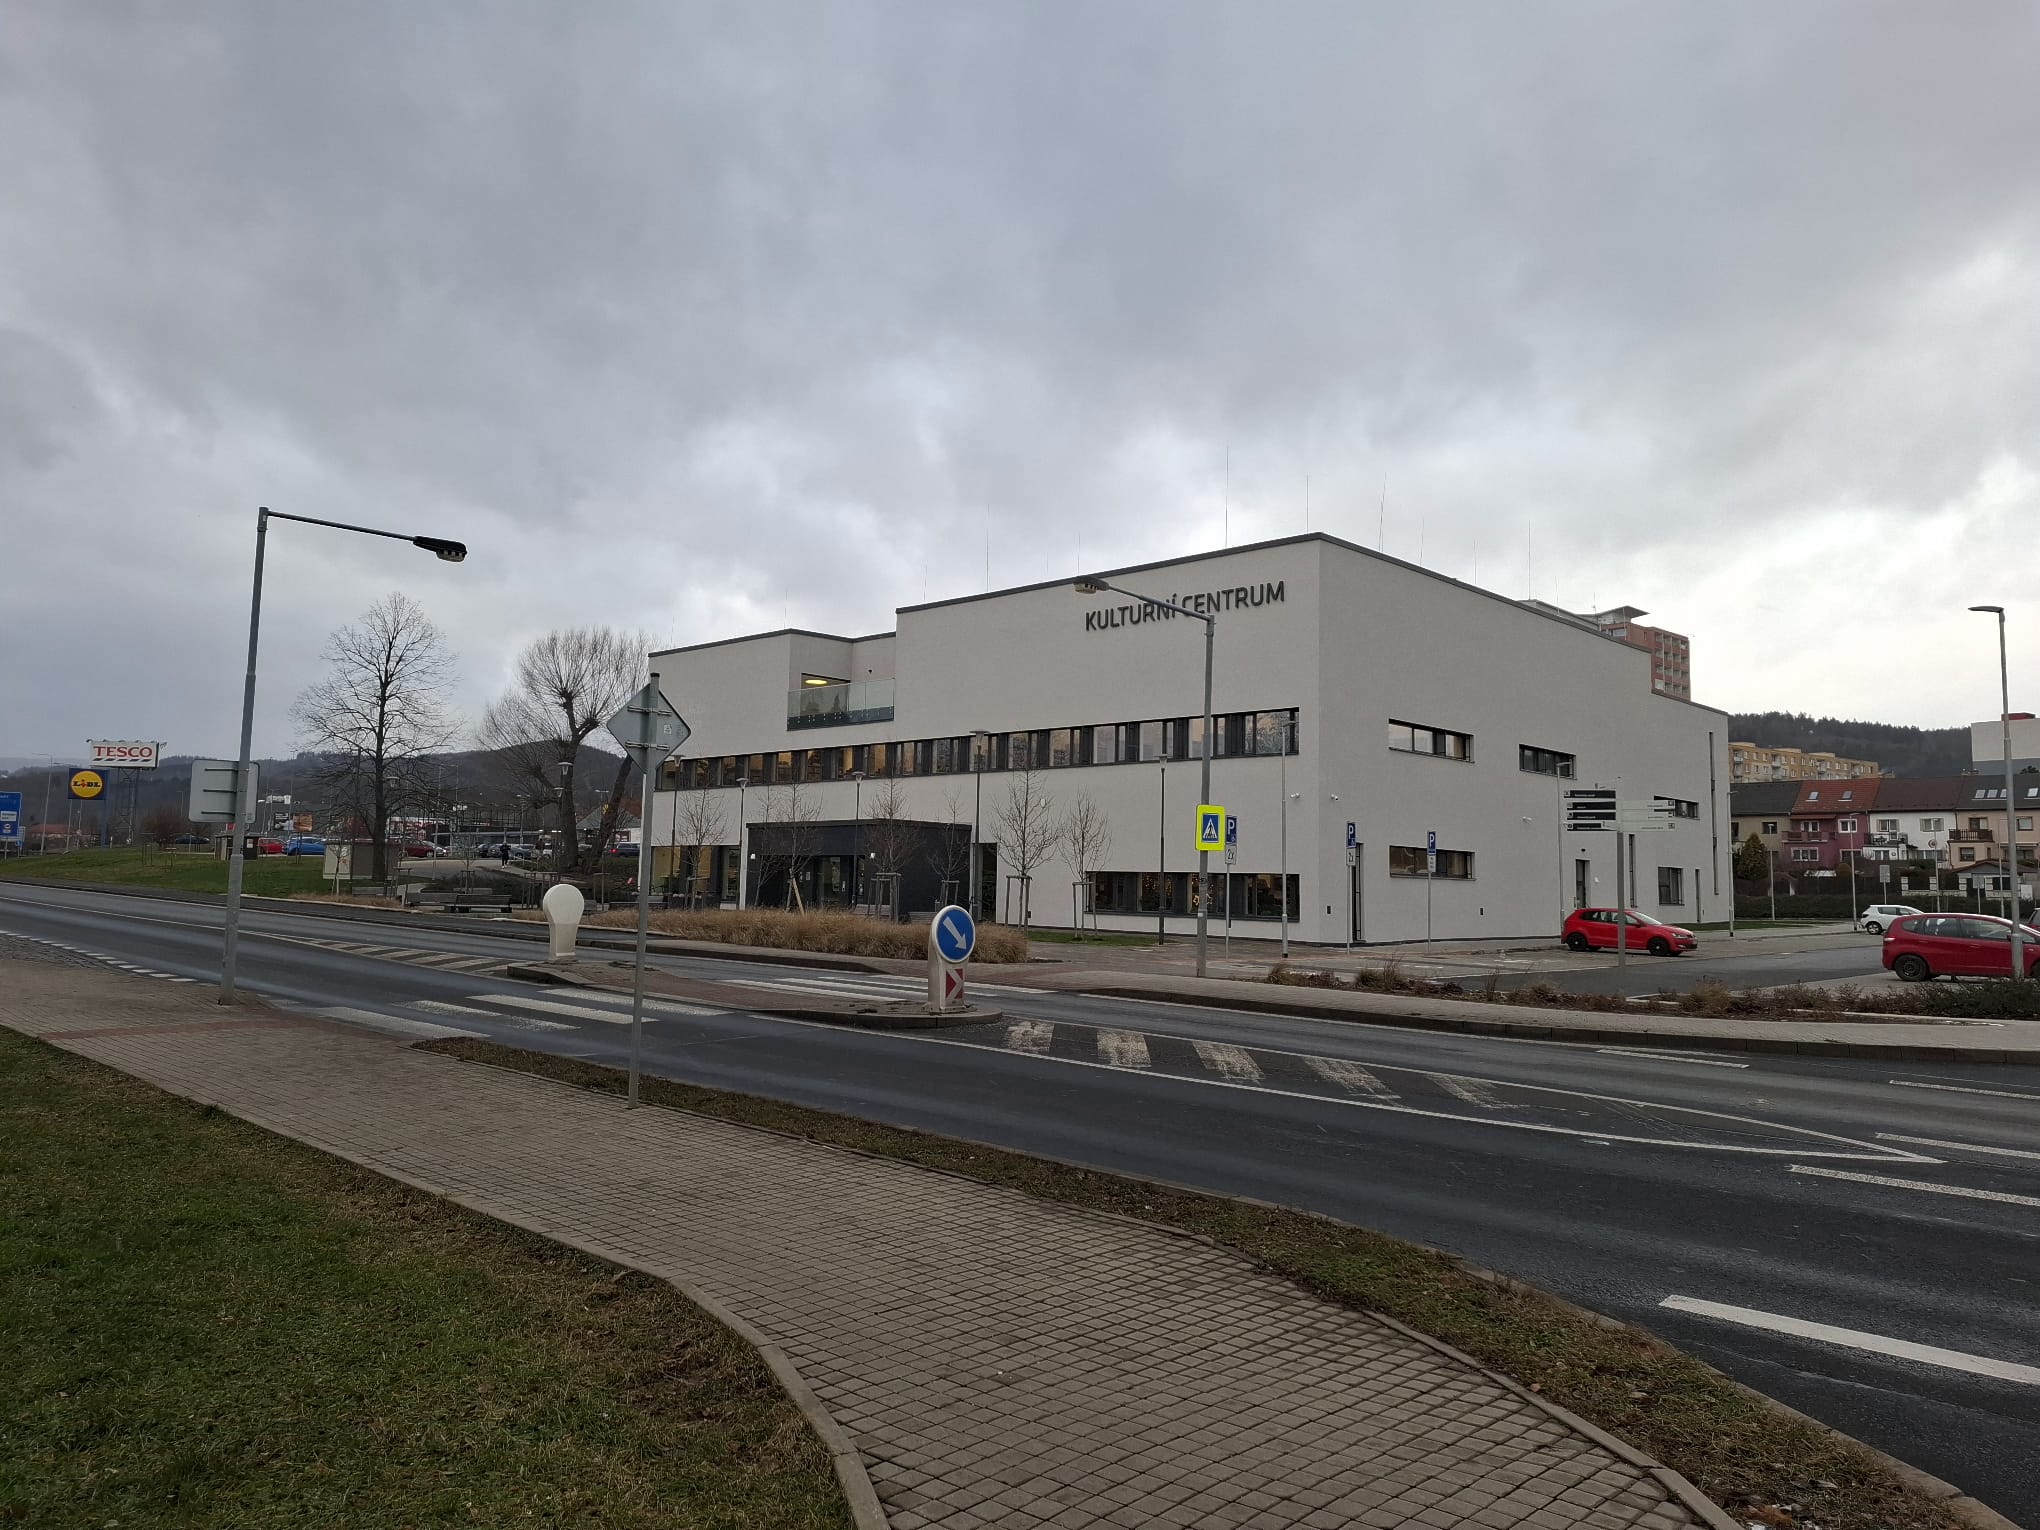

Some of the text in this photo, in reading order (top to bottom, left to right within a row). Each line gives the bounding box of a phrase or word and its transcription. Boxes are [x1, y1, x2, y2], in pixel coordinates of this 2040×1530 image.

[1182, 581, 1285, 616] CENTRUM
[93, 746, 153, 758] TESCO
[1228, 819, 1235, 835] P
[1349, 825, 1354, 840] P
[1430, 833, 1435, 848] P
